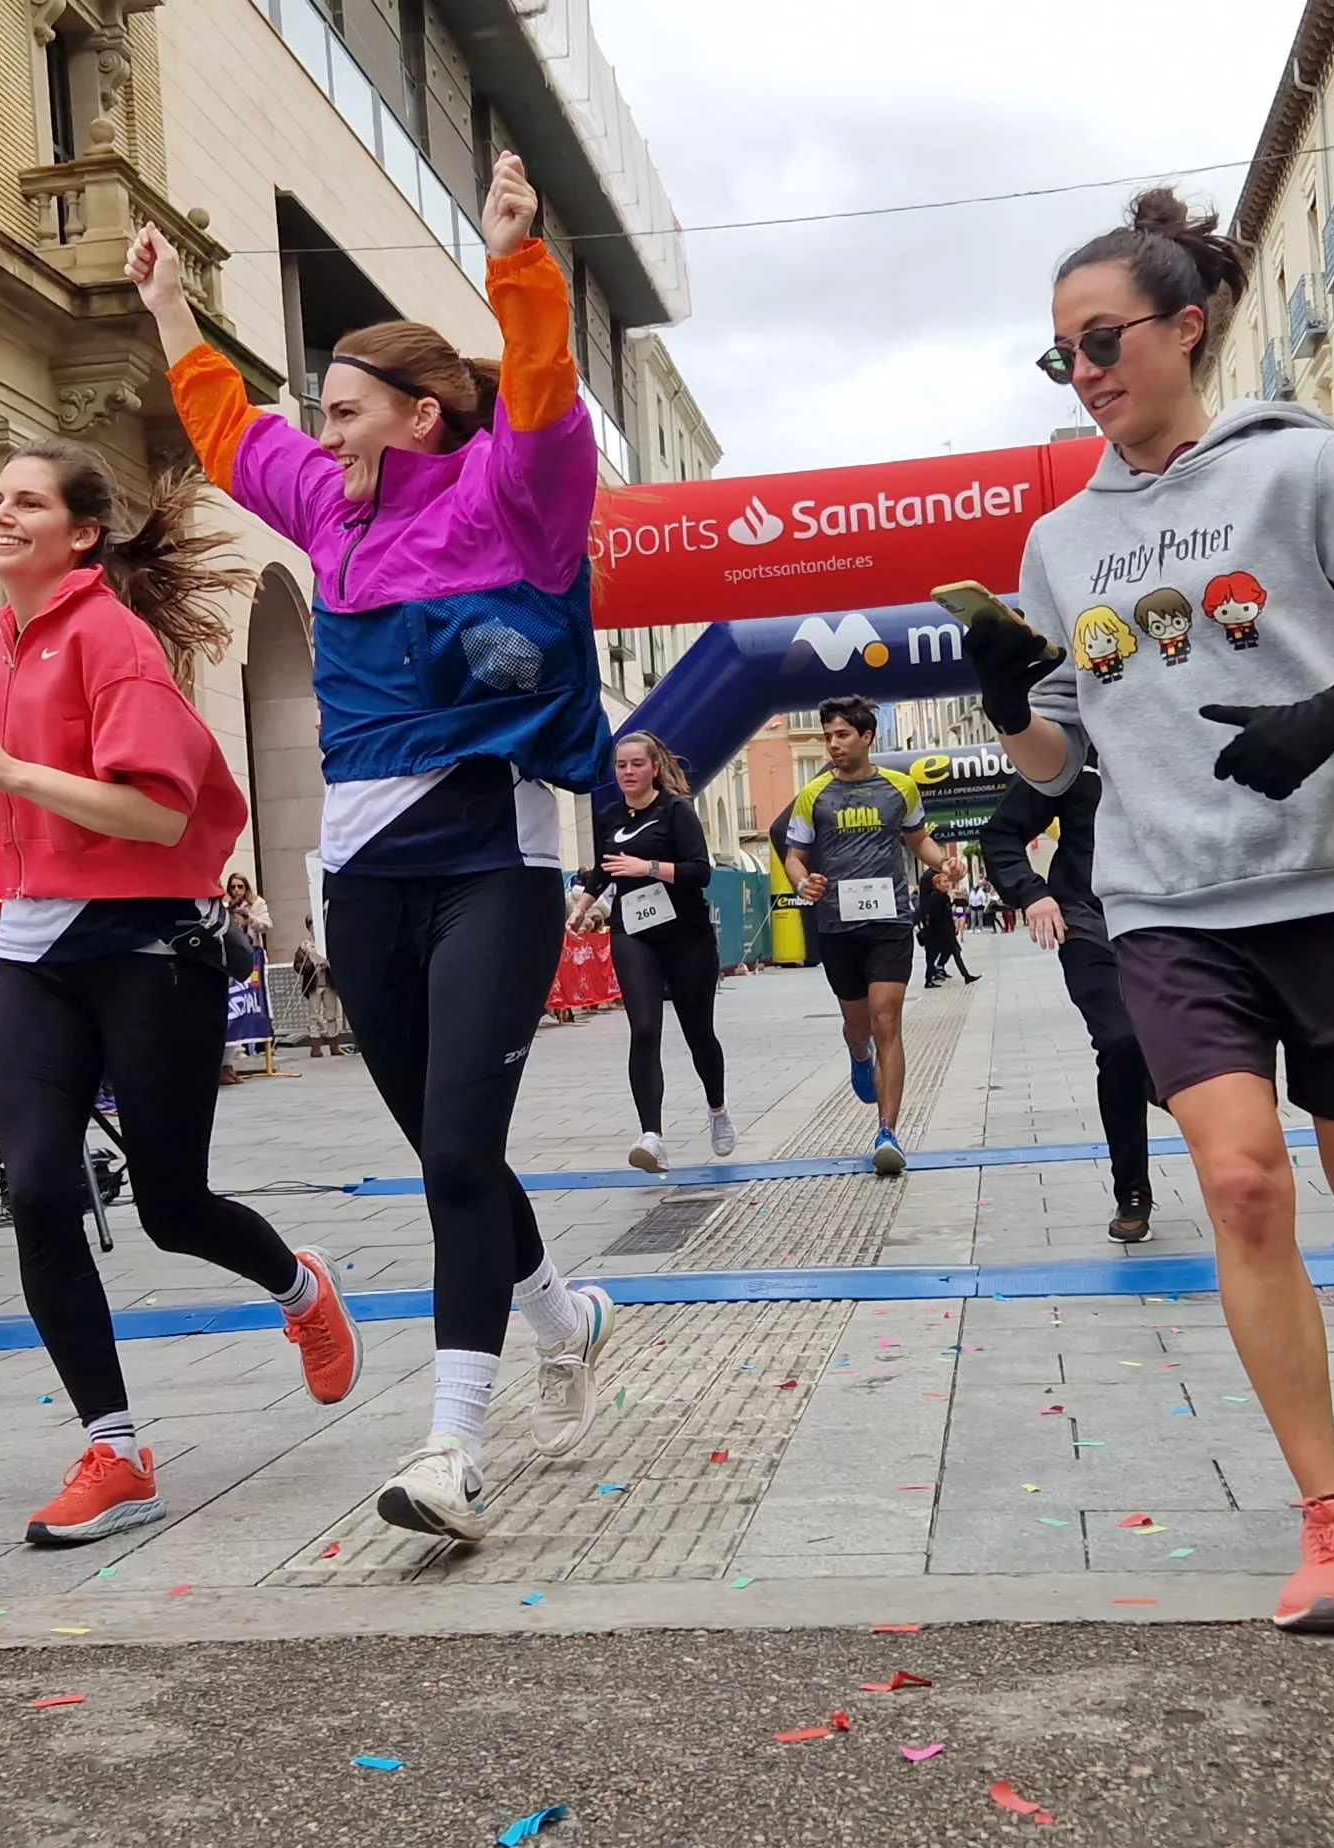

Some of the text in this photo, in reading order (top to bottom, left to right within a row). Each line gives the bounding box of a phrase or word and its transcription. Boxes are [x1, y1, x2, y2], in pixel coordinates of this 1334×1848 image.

[792, 481, 1030, 540] Santander
[724, 553, 874, 584] sportssantander.es
[1090, 523, 1234, 595] Harry Potter
[635, 906, 657, 921] 260
[858, 900, 879, 910] 261
